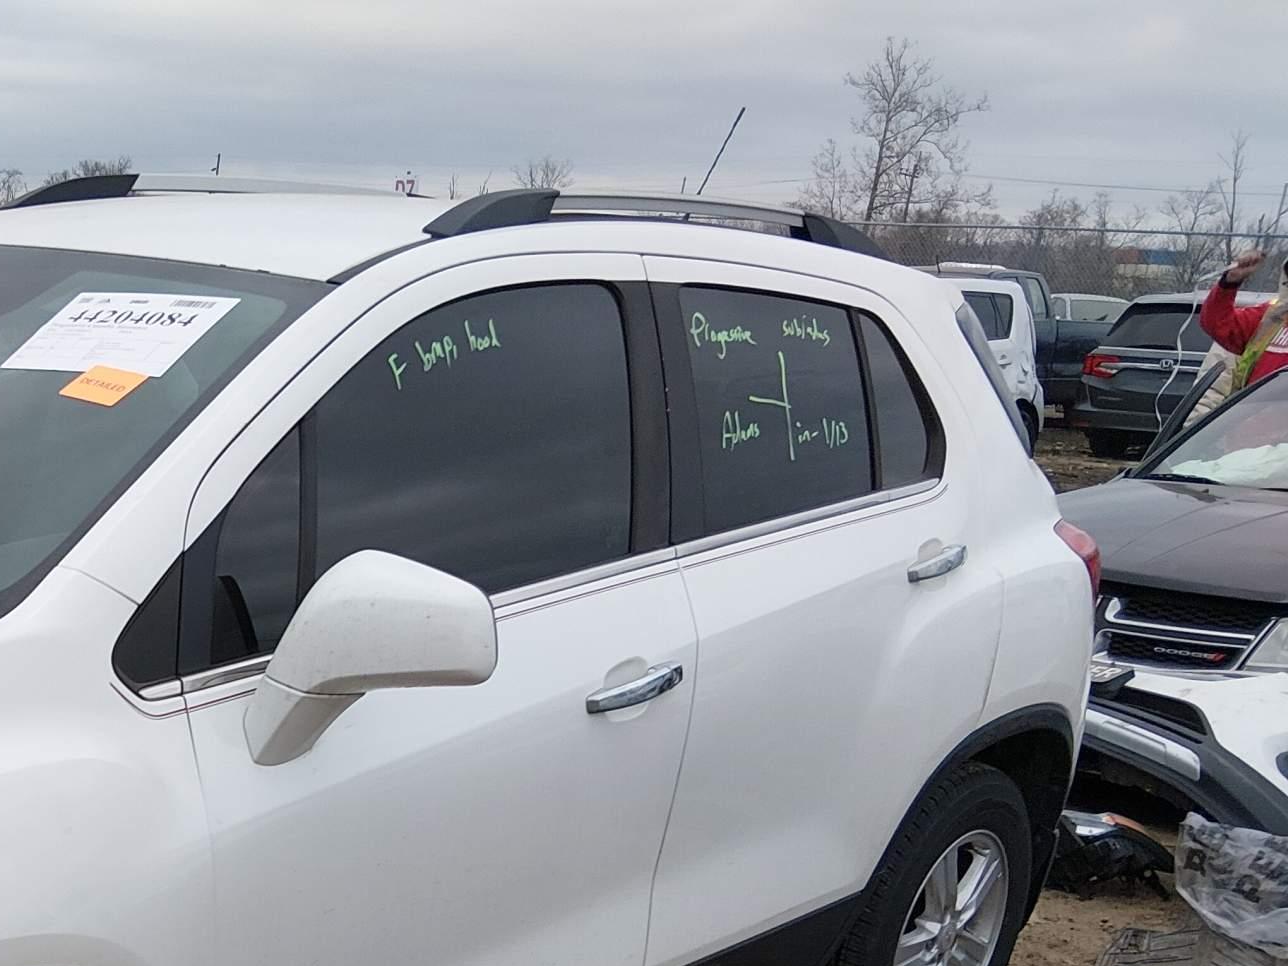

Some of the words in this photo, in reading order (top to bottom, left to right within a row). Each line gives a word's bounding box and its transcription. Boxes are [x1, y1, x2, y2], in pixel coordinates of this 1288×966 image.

[68, 309, 199, 327] 44204084
[388, 352, 408, 390] F
[464, 319, 502, 352] hood
[822, 418, 849, 449] 1/13
[1153, 646, 1213, 661] DODGE
